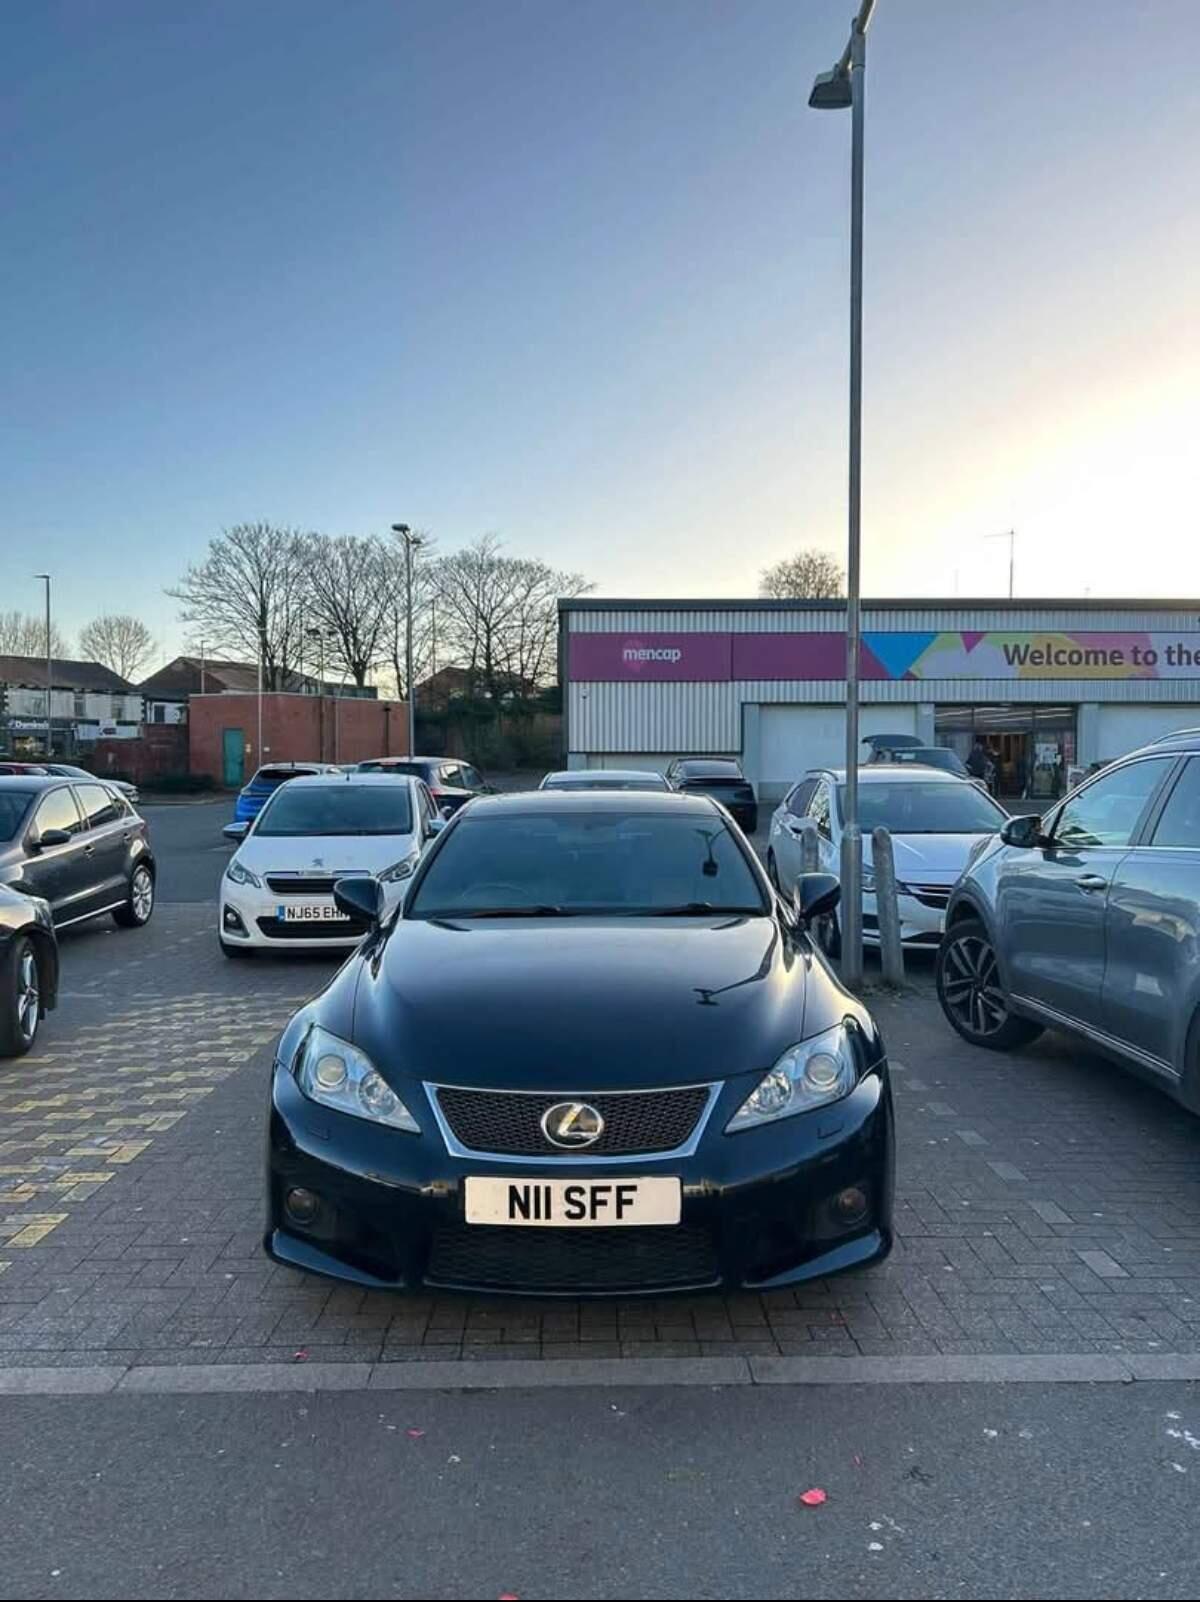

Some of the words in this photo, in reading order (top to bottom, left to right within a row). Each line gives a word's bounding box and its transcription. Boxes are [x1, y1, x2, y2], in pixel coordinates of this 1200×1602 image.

[623, 648, 681, 663] mencap
[1003, 644, 1124, 665] Welcome
[1131, 646, 1158, 666] to
[287, 906, 321, 919] NJ65
[323, 906, 344, 919] EH
[564, 1184, 638, 1220] SFF
